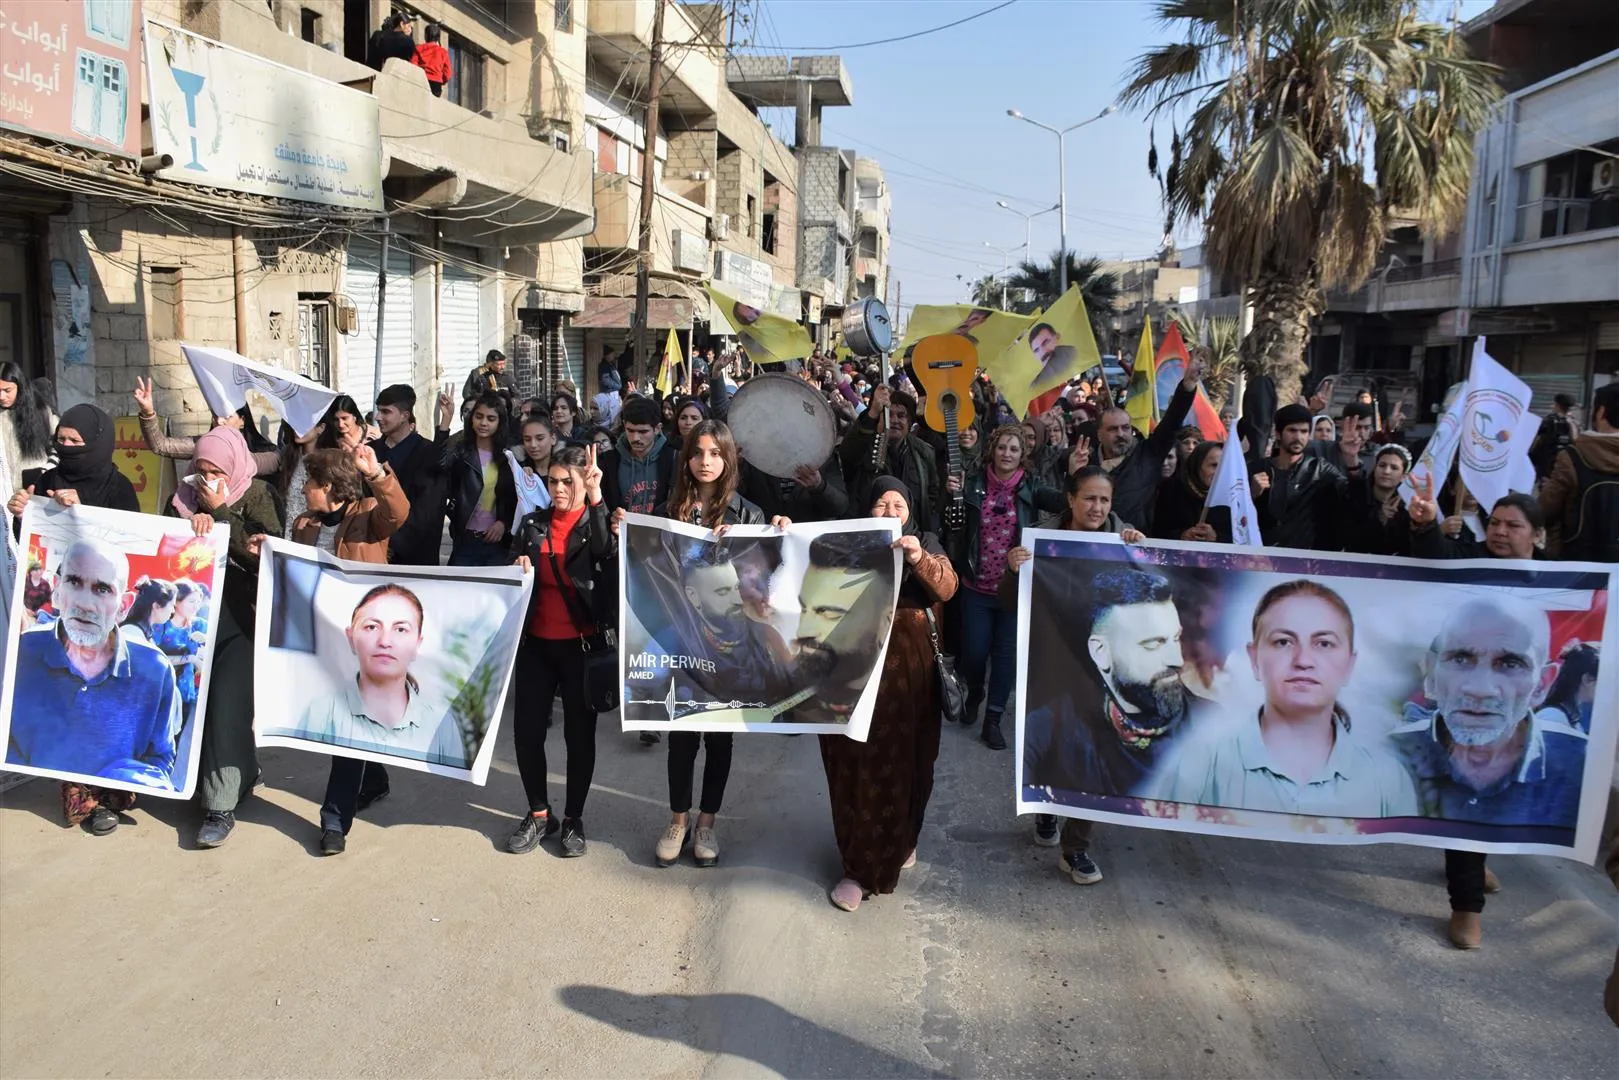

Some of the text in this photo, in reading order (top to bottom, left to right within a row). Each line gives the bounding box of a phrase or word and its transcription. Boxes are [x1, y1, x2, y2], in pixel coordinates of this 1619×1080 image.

[12, 21, 68, 55] أبواب
[3, 62, 60, 96] أبواب
[302, 149, 325, 170] جامعة
[629, 652, 717, 673] MÎR PERWER
[628, 671, 654, 680] AMED
